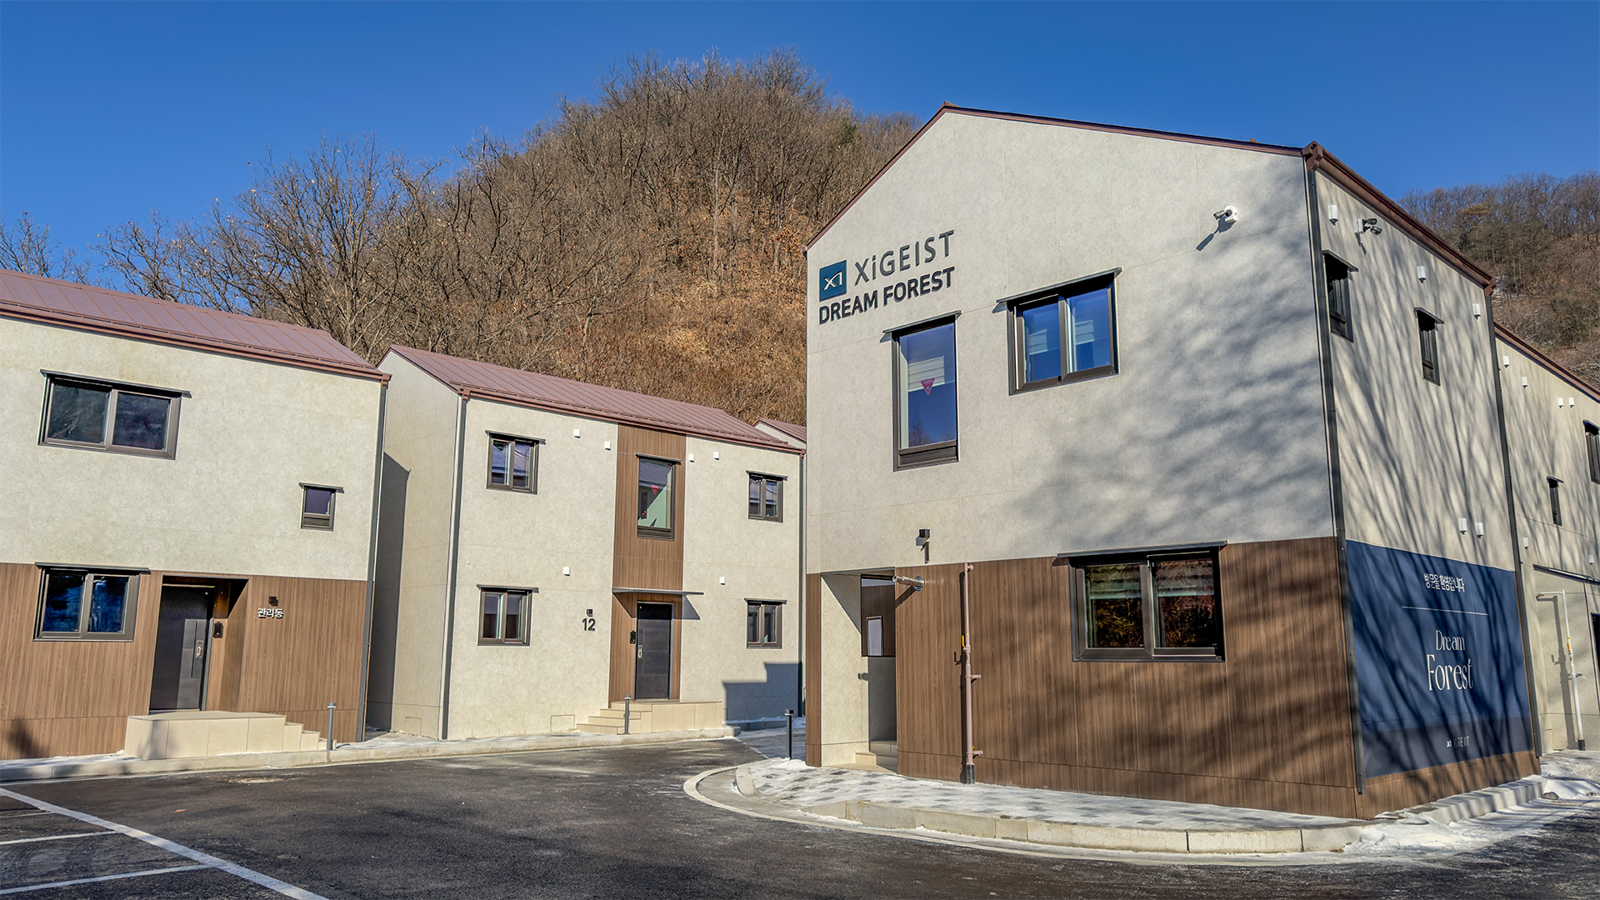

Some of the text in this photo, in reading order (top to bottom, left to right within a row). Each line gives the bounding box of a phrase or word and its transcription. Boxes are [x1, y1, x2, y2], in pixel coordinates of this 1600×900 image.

[854, 230, 955, 286] XiGEIST
[819, 266, 955, 325] DREAM FOREST
[920, 541, 930, 564] 1
[257, 608, 284, 619] 관리동
[582, 618, 596, 632] 12
[1435, 629, 1466, 651] Dream
[1426, 653, 1474, 691] Forest
